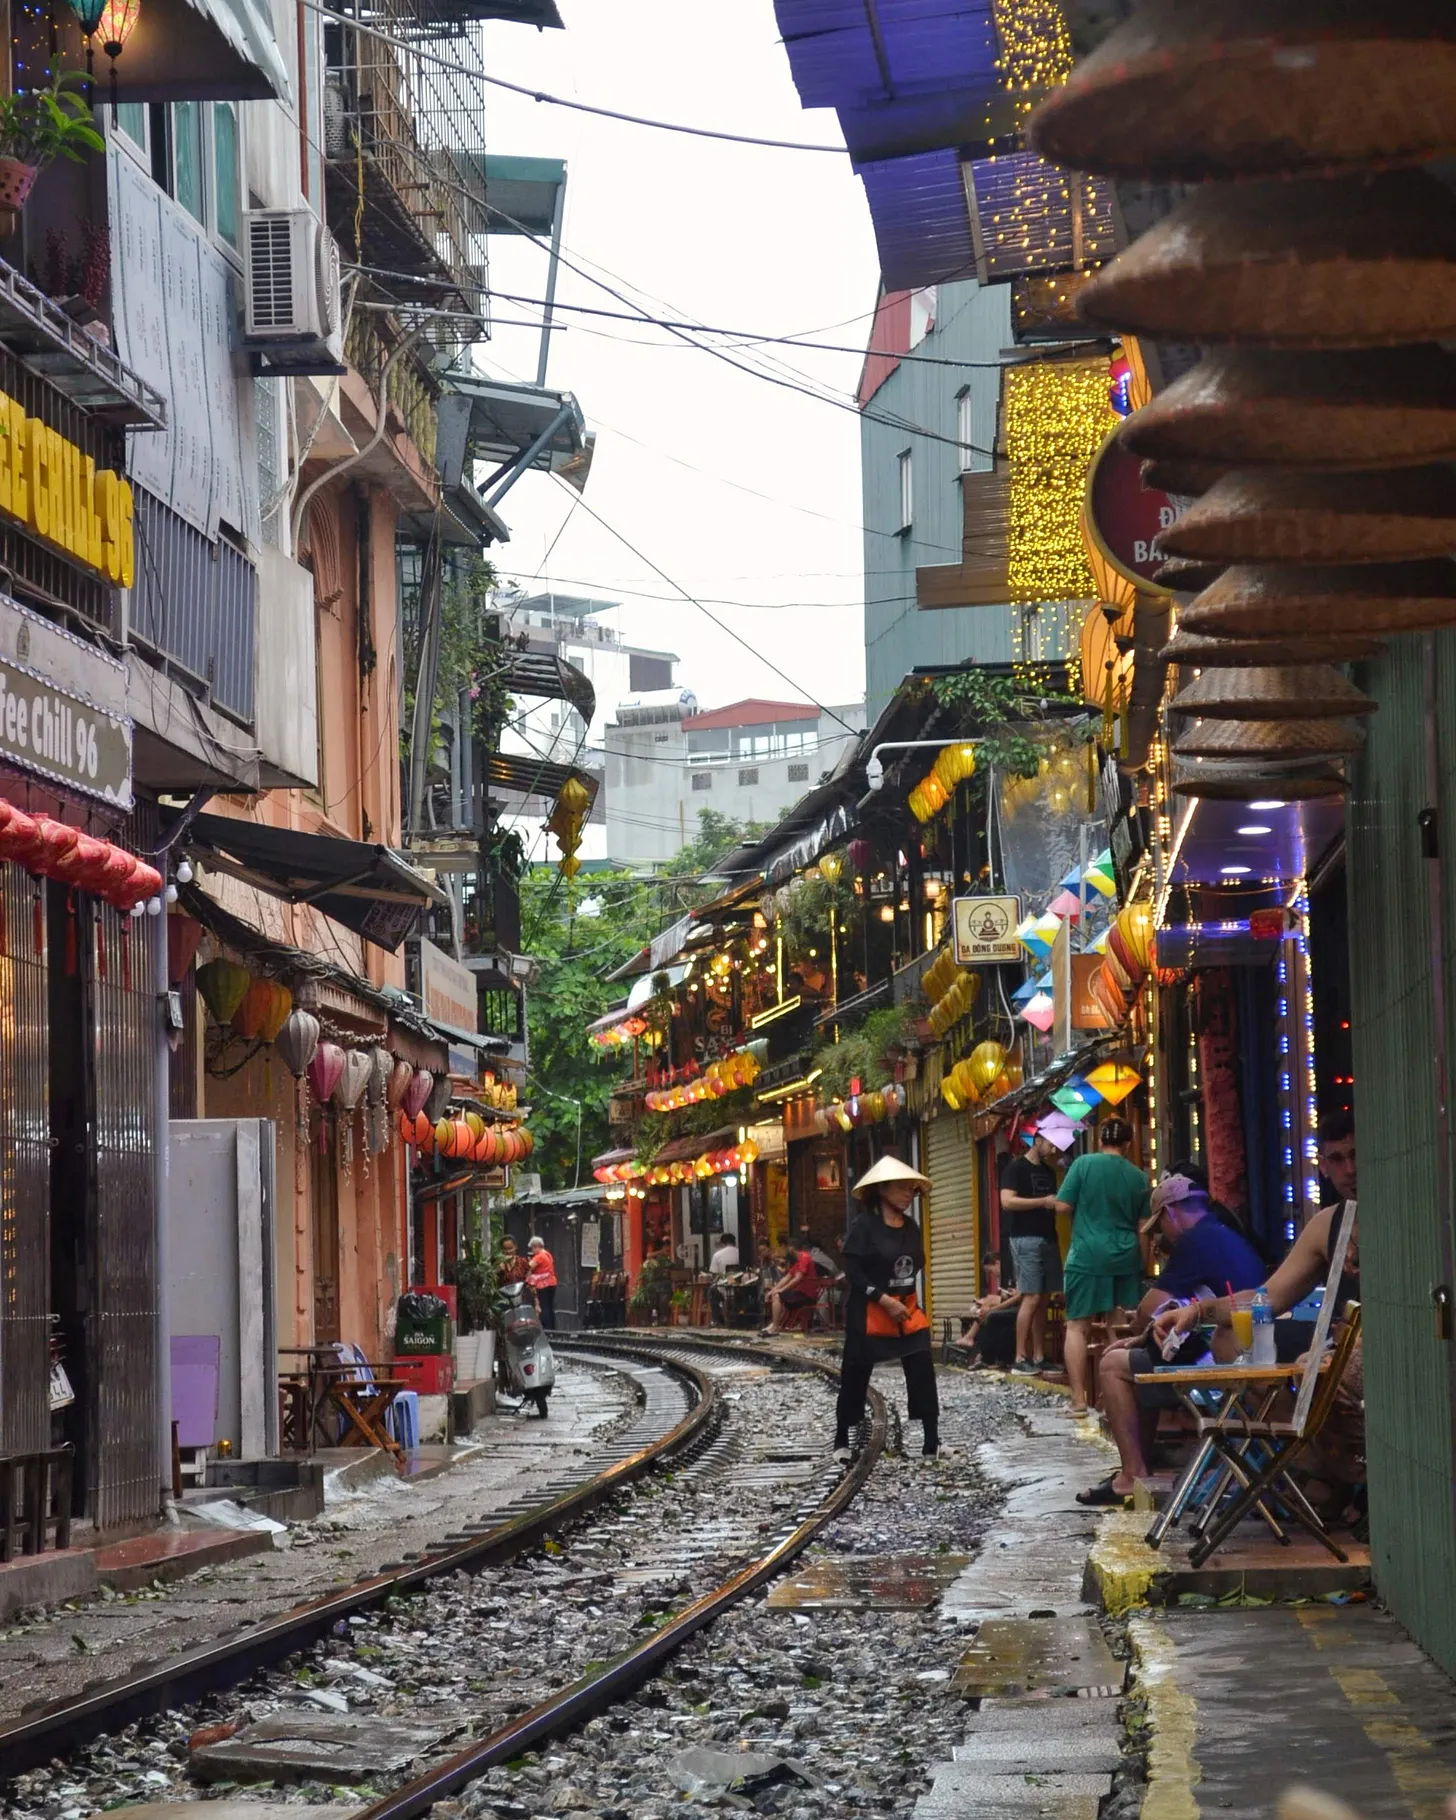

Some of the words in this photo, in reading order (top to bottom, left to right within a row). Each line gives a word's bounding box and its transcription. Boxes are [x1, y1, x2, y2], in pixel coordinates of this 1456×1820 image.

[29, 417, 103, 570] CHILL
[97, 469, 134, 589] 96
[32, 696, 73, 769] Chill
[76, 718, 98, 779] 96
